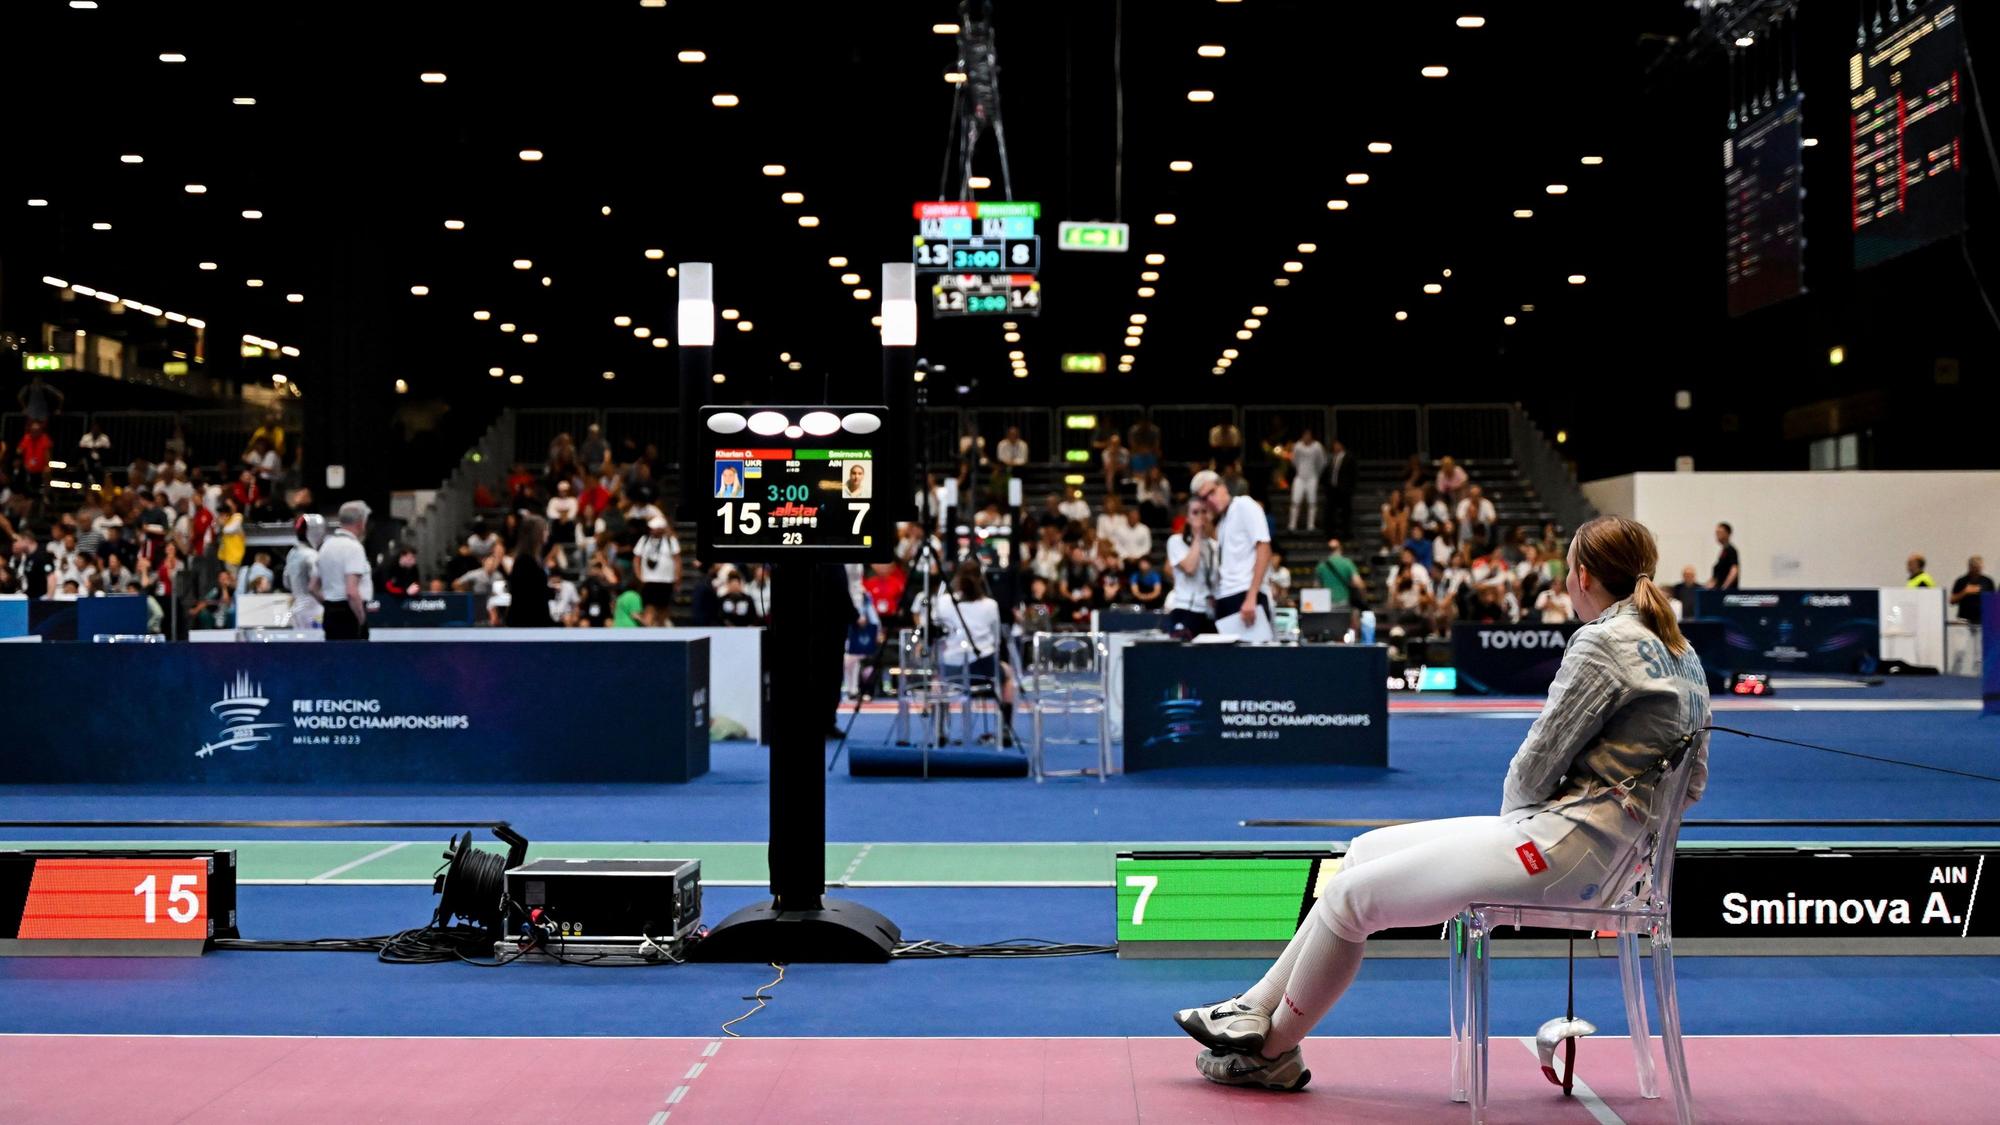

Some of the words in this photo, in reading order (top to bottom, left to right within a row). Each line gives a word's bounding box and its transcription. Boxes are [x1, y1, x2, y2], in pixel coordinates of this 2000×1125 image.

[918, 244, 949, 265] 13
[955, 250, 999, 268] 3:00
[1012, 244, 1030, 265] 8
[937, 291, 964, 310] 12
[968, 296, 1006, 312] 3:00
[1012, 289, 1039, 307] 14
[828, 450, 863, 458] Smirnova
[864, 450, 872, 458] A.
[768, 485, 809, 501] 3:00
[774, 502, 818, 517] allstar
[716, 502, 762, 535] 15
[848, 502, 871, 535] 7
[782, 532, 802, 545] 2/3
[1478, 630, 1566, 649] TOYOTA
[293, 699, 312, 713] FIE
[315, 699, 381, 713] FENCING
[1220, 700, 1239, 713] FIE
[1240, 700, 1296, 713] FENCING
[293, 715, 347, 729] WORLD
[349, 715, 469, 729] CHAMPIONSHIPS
[1221, 714, 1268, 727] WORLD
[1268, 714, 1371, 727] CHAMPIONSHIPS
[293, 735, 330, 744] MILAN
[333, 735, 361, 745] 2023
[1221, 731, 1254, 739] MILAN
[1255, 730, 1280, 739] 2023
[1929, 866, 1968, 883] AIN
[134, 874, 199, 924] 15
[1125, 875, 1158, 925] 7
[1722, 892, 1912, 925] Smirnova
[1921, 891, 1962, 924] A.
